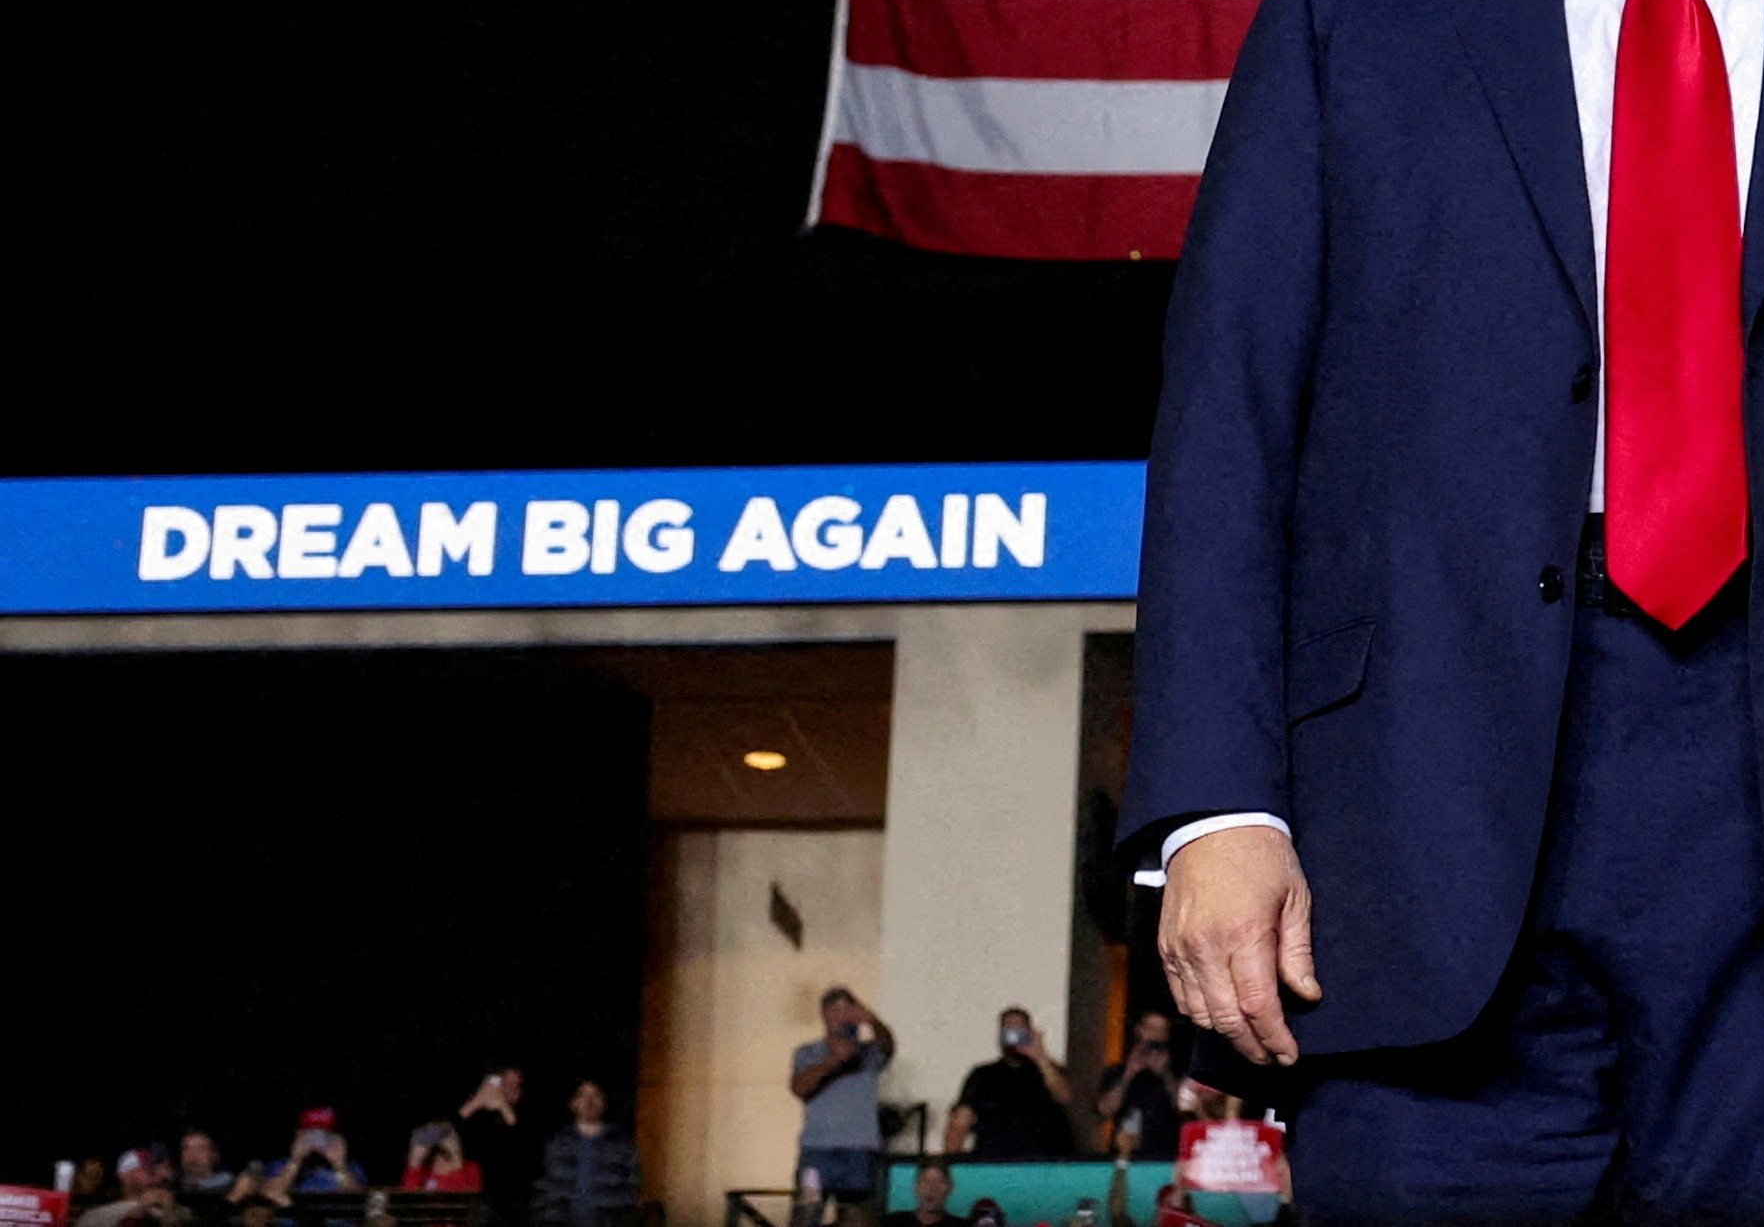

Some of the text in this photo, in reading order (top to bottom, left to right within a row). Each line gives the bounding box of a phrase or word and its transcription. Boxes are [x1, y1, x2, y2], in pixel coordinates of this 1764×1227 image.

[139, 493, 1046, 580] DREAM BIG AGAIN
